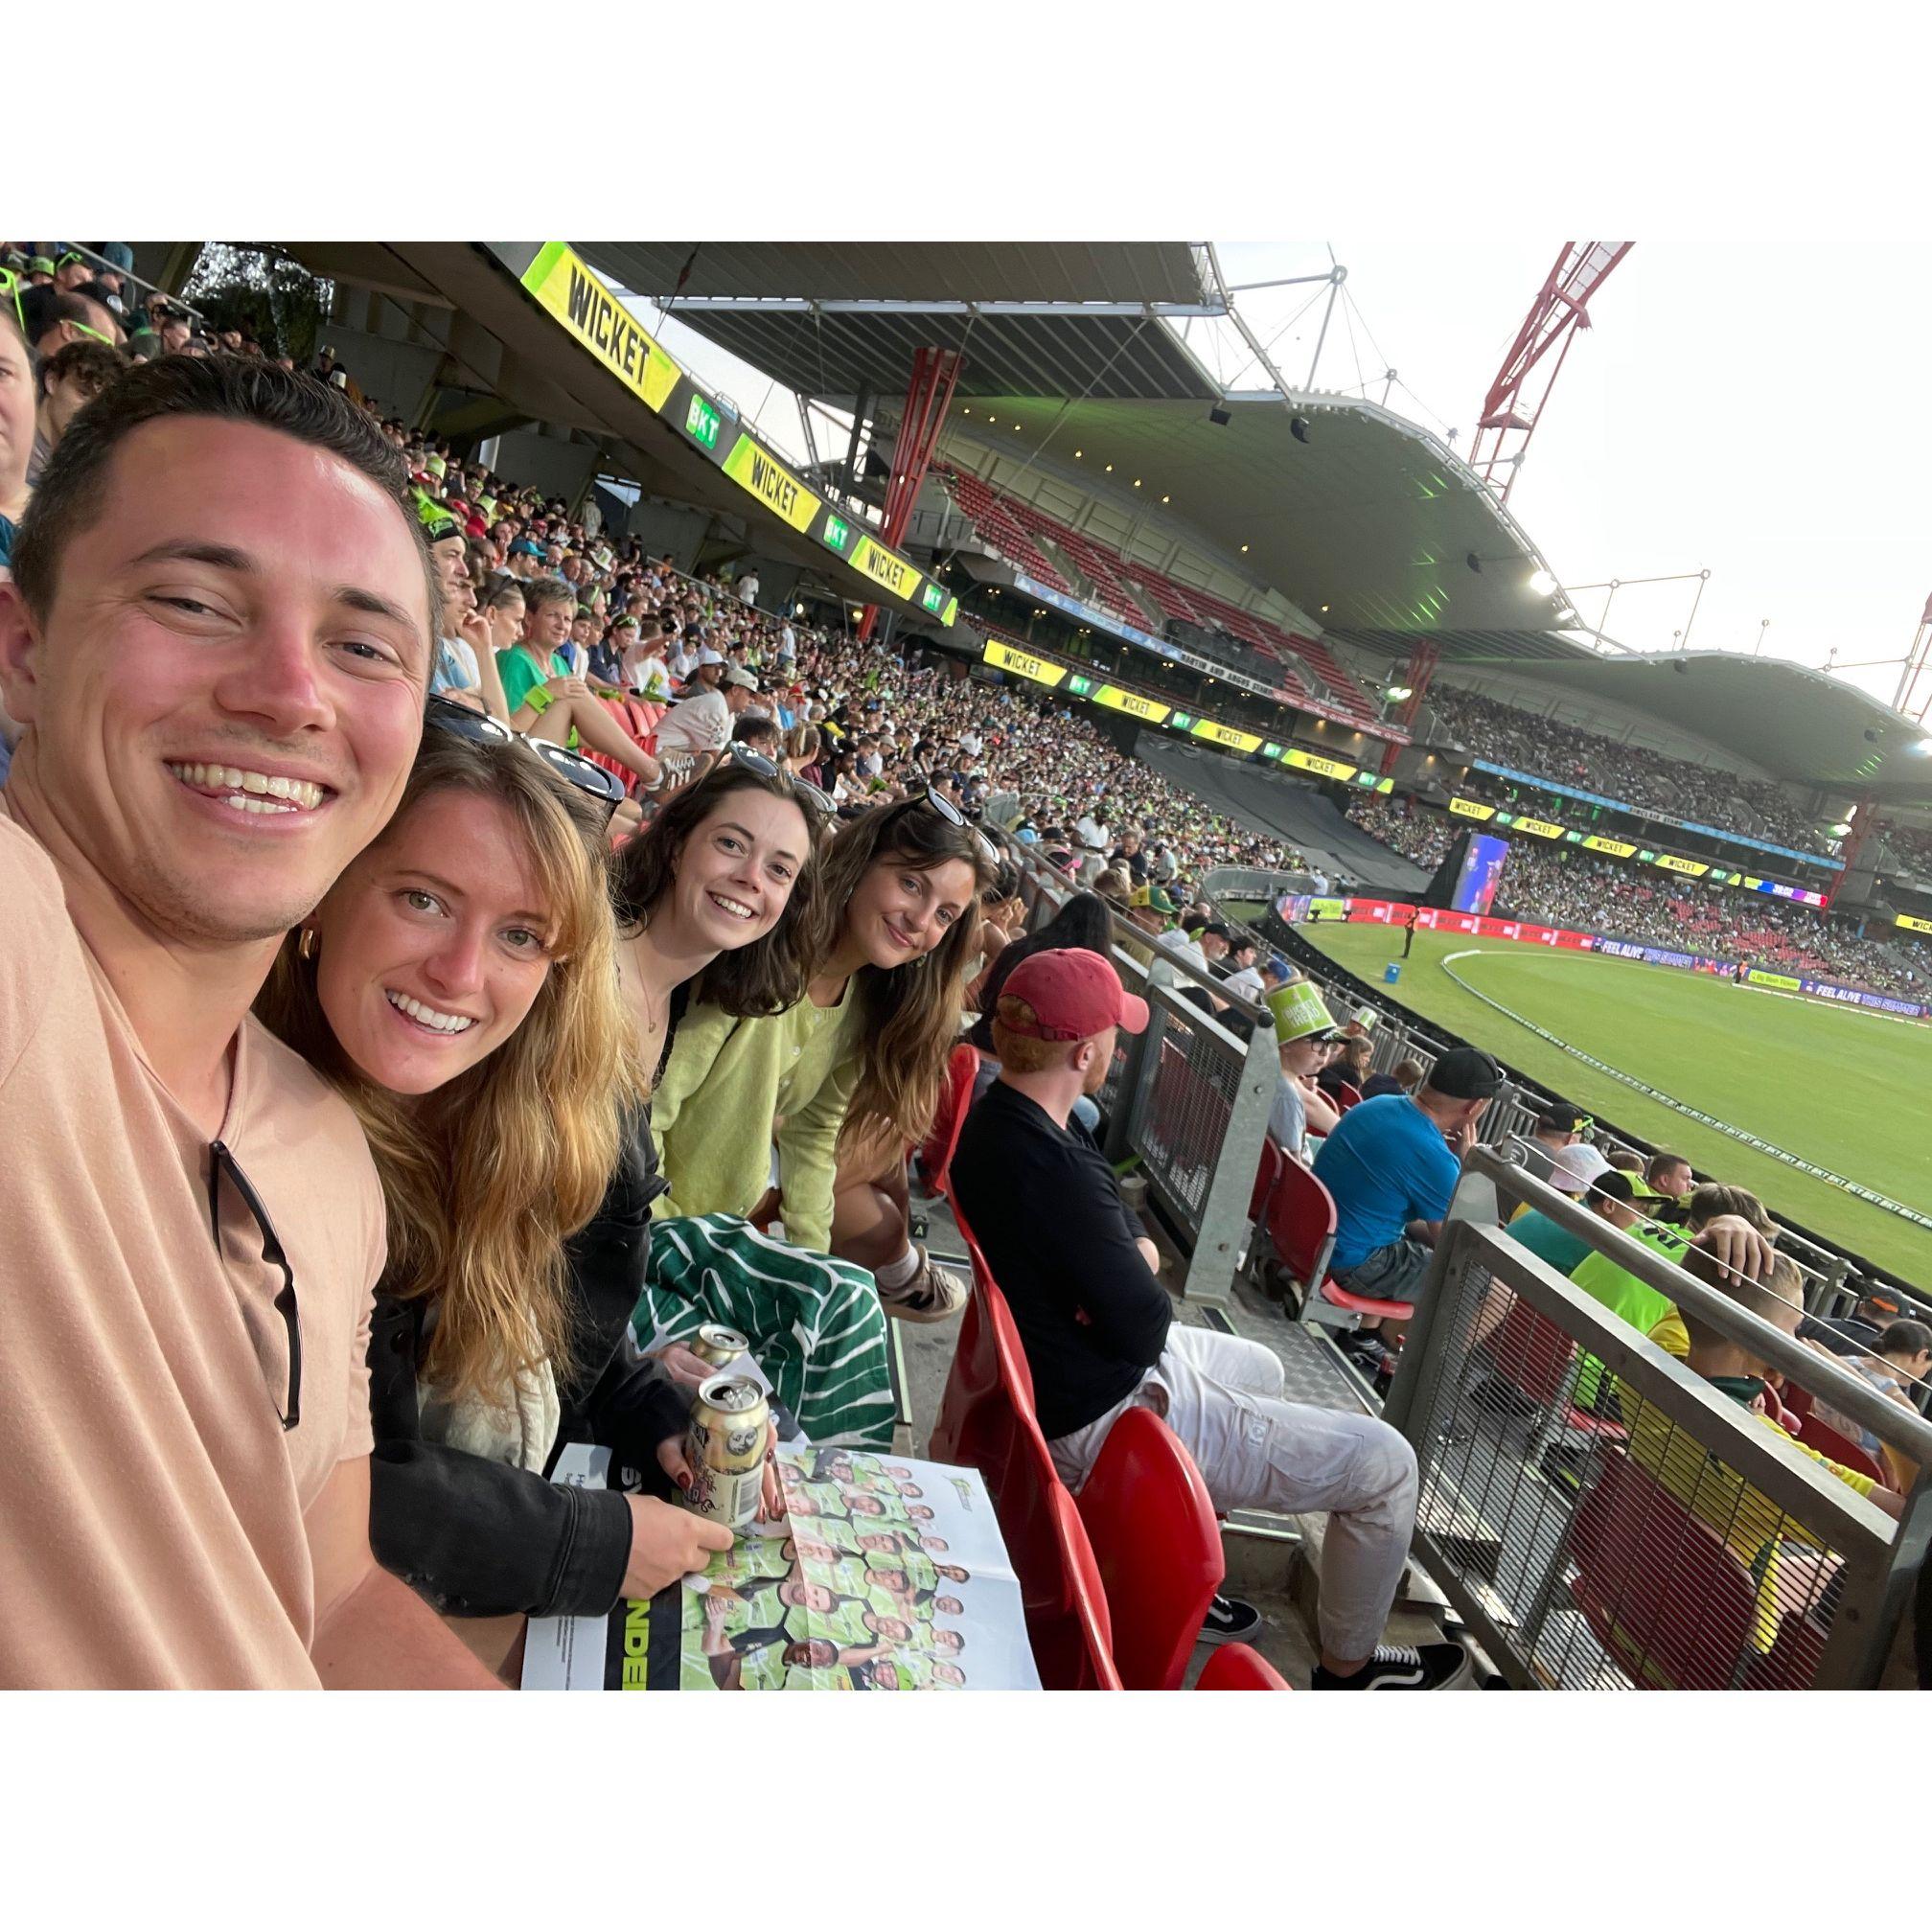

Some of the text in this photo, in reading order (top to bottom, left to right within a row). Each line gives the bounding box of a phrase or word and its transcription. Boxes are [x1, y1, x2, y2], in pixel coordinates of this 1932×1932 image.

[568, 263, 650, 385] WICKET
[687, 403, 720, 444] BKT
[751, 451, 797, 517] WICKET
[826, 519, 848, 548] BKT
[867, 545, 905, 590] WICKET
[1002, 649, 1042, 677] WICKET
[1121, 694, 1150, 715] WICKET
[1215, 727, 1242, 746] WICKET
[1306, 757, 1335, 774] WICKET
[1454, 799, 1482, 816] WICKET
[1525, 819, 1552, 835] WICKET
[1596, 839, 1622, 854] WICKET
[1668, 857, 1695, 872] WICKET
[1601, 940, 1622, 954] FEEL
[1816, 984, 1836, 999] FEEL
[1835, 989, 1861, 1003] ALIVE
[914, 1224, 924, 1237] A
